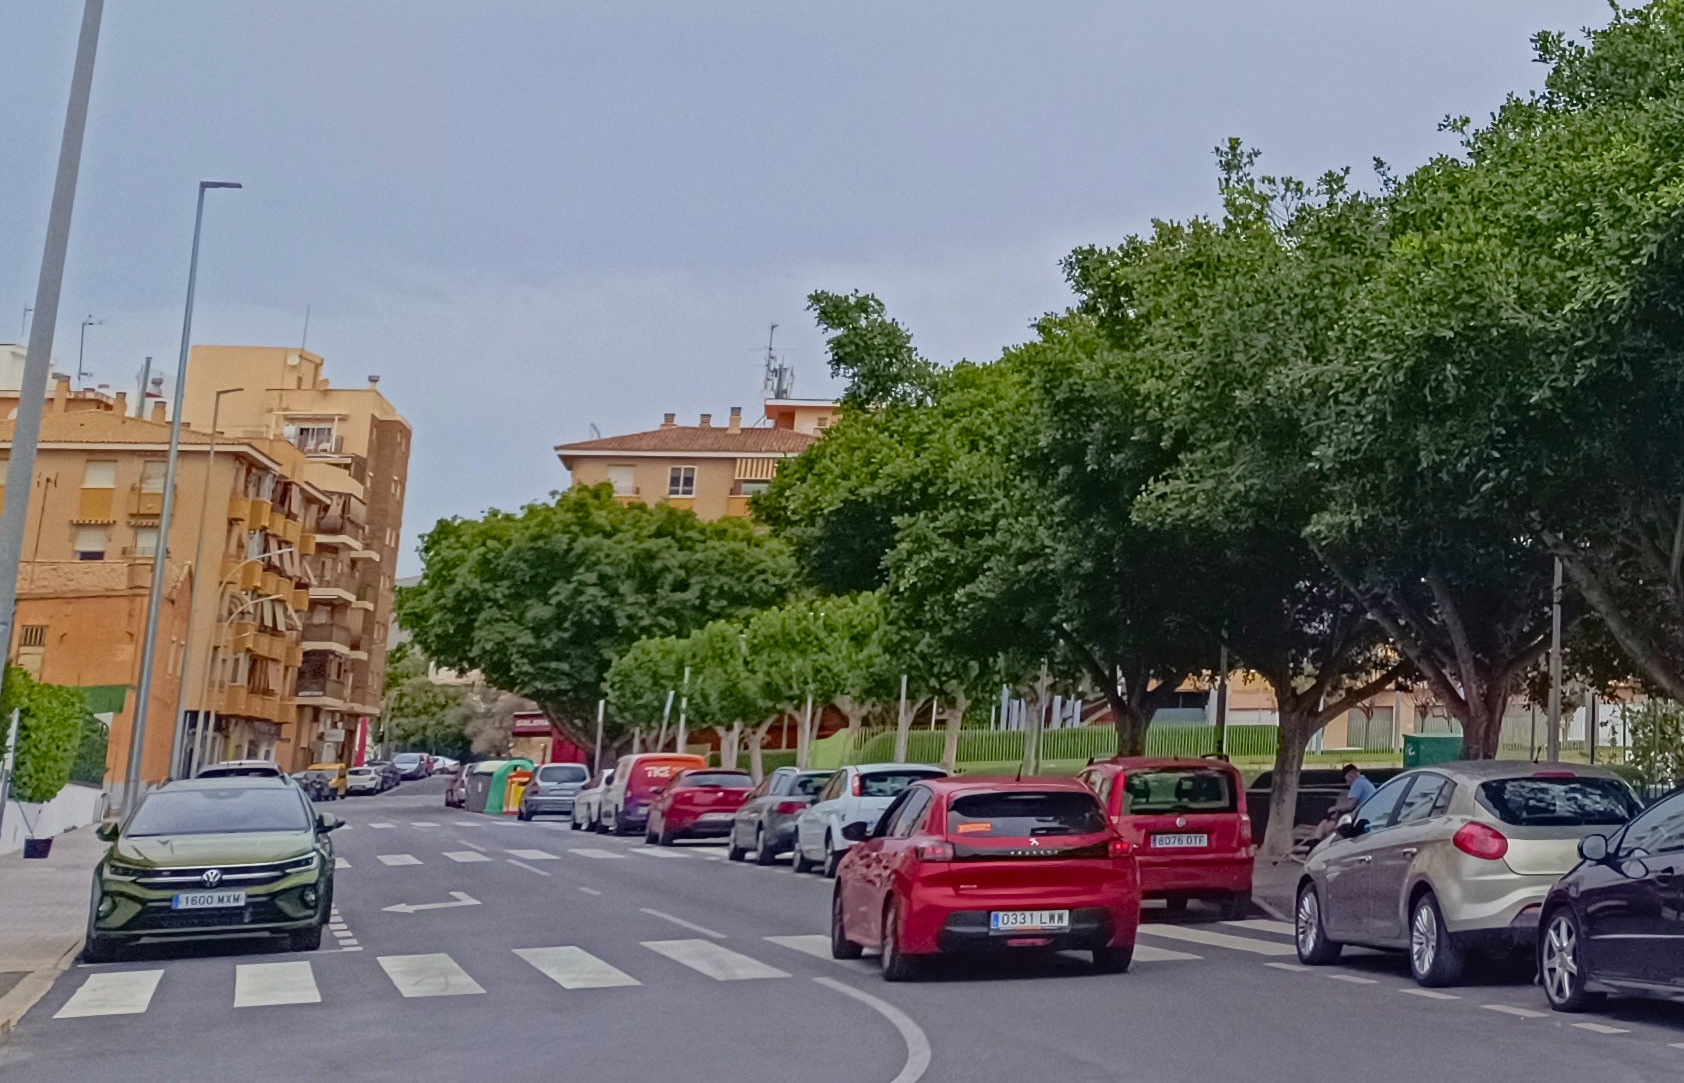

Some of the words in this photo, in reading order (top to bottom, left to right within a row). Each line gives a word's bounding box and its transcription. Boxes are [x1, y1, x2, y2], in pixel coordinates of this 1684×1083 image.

[1158, 835, 1183, 846] 8076
[1186, 835, 1205, 845] DTF
[185, 895, 214, 906] 1600
[1001, 913, 1034, 926] 0331
